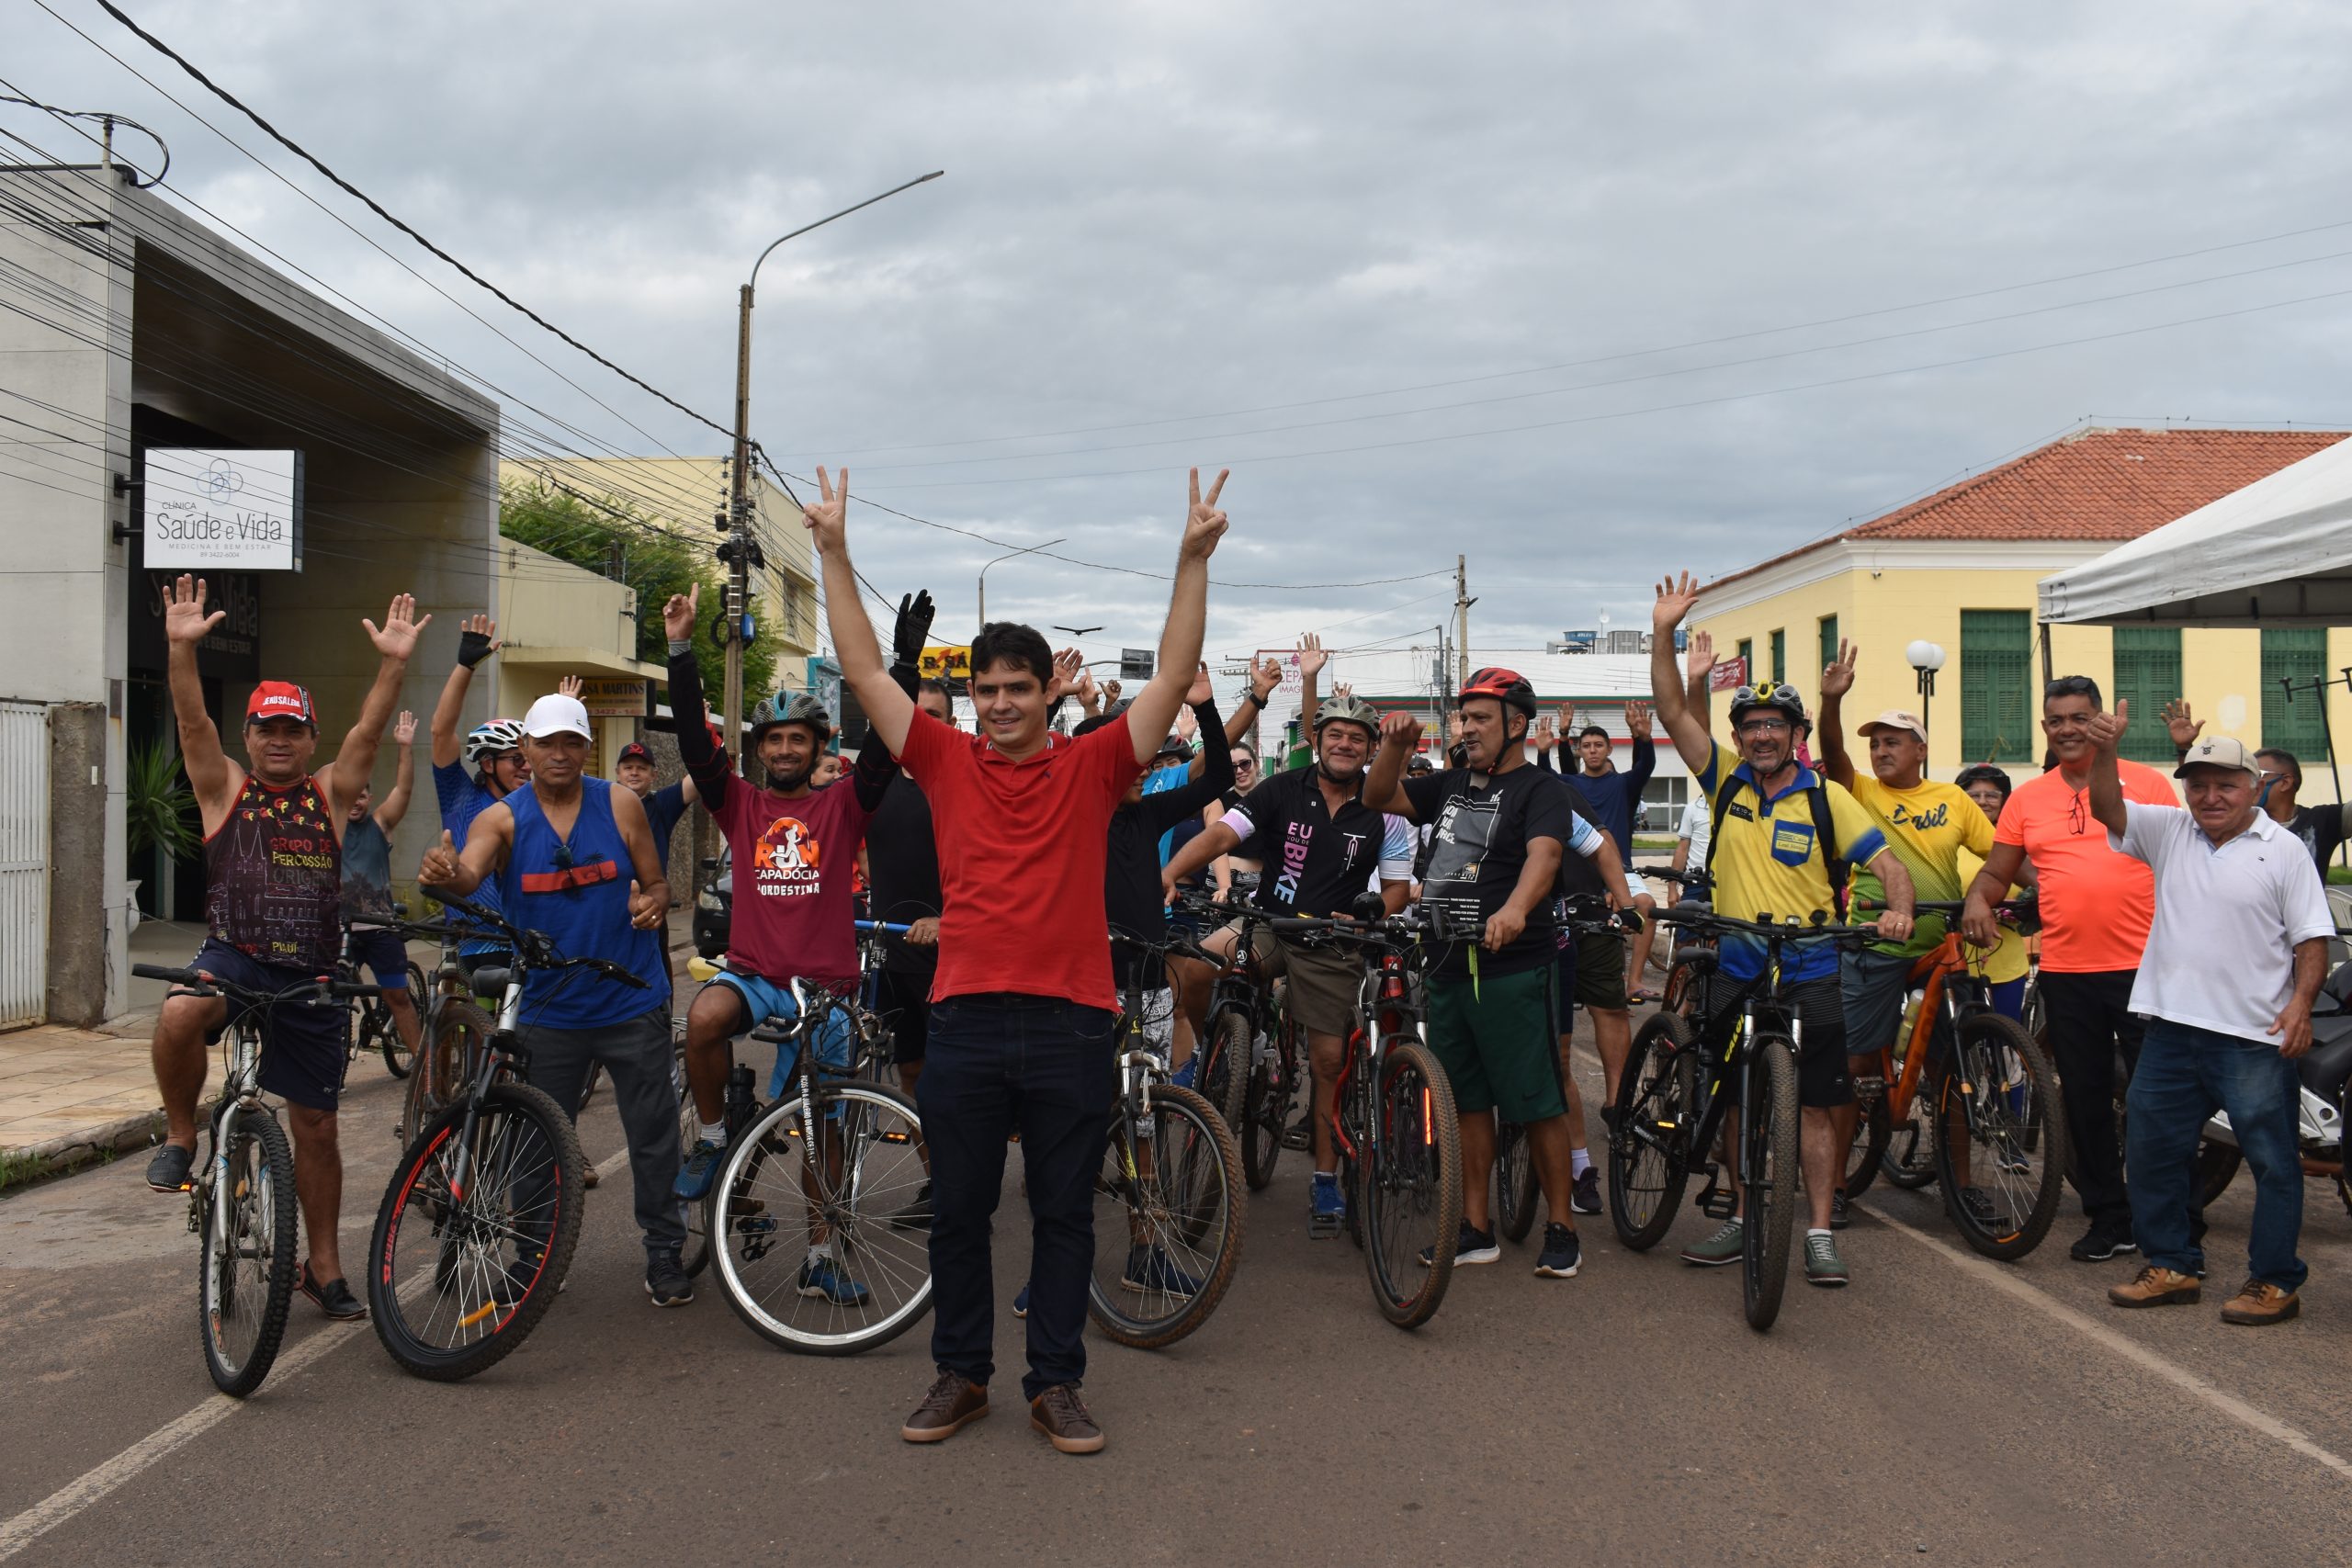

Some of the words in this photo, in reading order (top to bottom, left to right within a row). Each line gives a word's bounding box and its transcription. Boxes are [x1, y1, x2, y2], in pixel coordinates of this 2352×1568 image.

[162, 501, 197, 510] CLÍNICA
[157, 512, 221, 540] Saúde
[225, 525, 234, 540] e
[236, 512, 281, 540] Vida
[603, 682, 645, 694] MARTINS
[263, 695, 300, 708] JERUSALEM
[1287, 821, 1313, 840] EU
[319, 837, 332, 853] DE
[1286, 835, 1300, 843] VOU
[272, 851, 333, 868] PERCUSSÃO
[1273, 840, 1308, 905] BIKE
[757, 882, 820, 896] ORDESTINA
[272, 941, 298, 953] PIAUÍ
